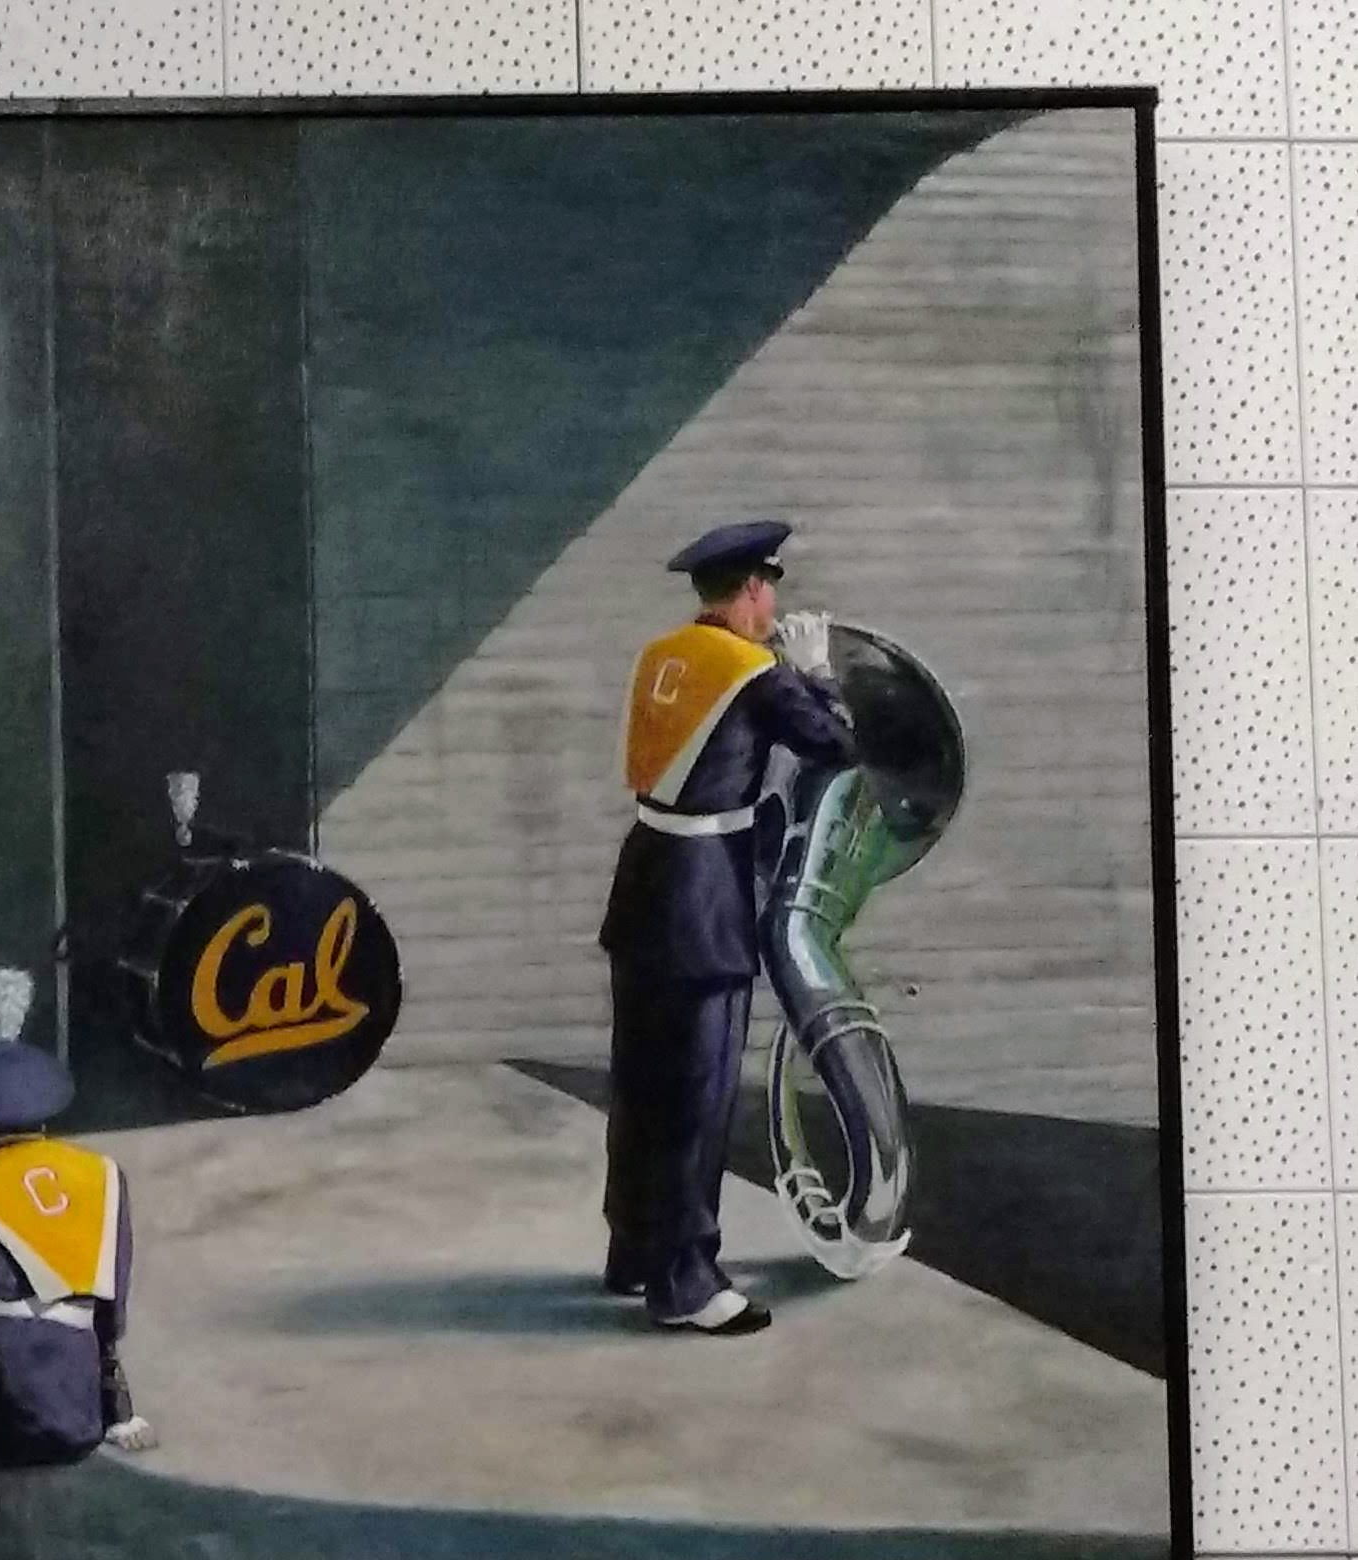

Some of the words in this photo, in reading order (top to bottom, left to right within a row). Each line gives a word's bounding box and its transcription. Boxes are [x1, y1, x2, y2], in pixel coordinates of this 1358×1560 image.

[653, 659, 686, 704] C
[192, 897, 369, 1069] Cal
[23, 1166, 69, 1215] C
